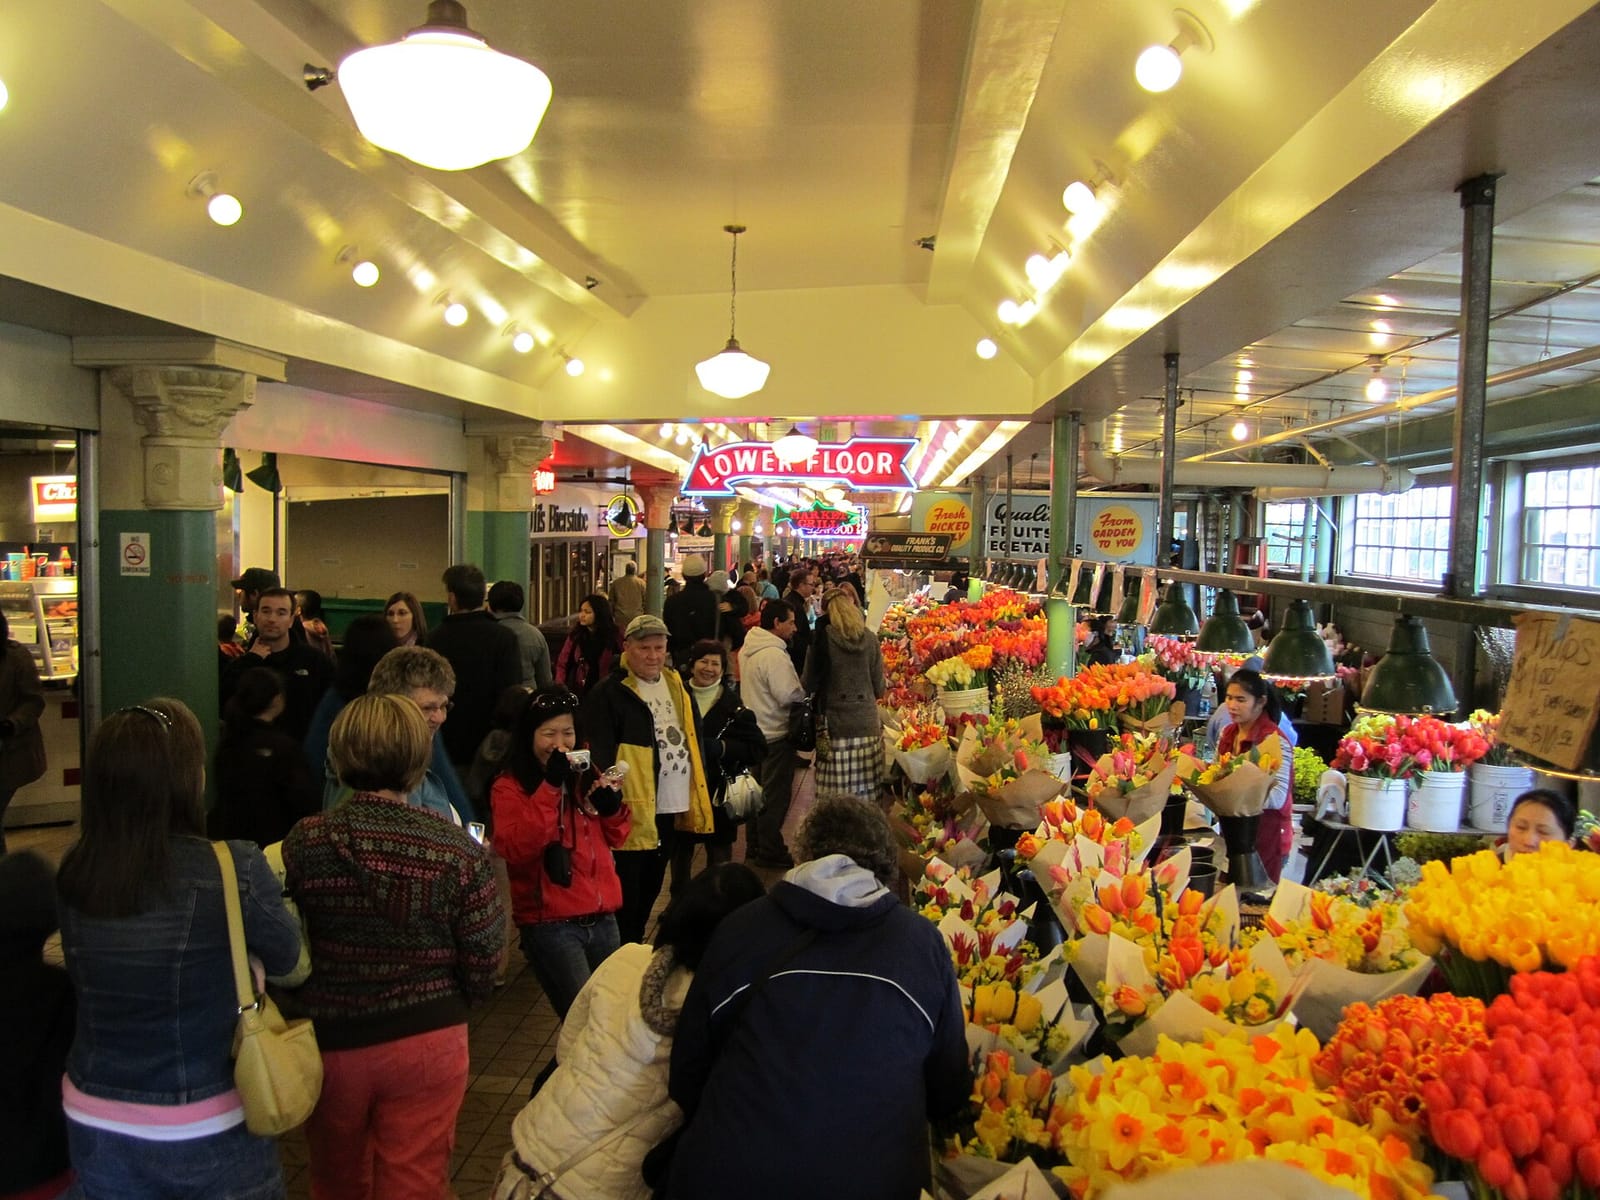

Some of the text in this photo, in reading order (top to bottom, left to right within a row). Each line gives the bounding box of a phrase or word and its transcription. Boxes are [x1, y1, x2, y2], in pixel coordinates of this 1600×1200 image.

[699, 449, 893, 486] LOWER FLOOR
[548, 504, 589, 533] Bierstube
[790, 511, 848, 520] MARKET
[934, 505, 966, 521] Fresh
[797, 520, 837, 529] GRILL
[1099, 513, 1135, 528] From
[929, 521, 970, 532] PICKED
[1093, 528, 1136, 539] GARDEN
[905, 536, 937, 545] FRANK'S
[1099, 538, 1136, 549] TO YOU
[890, 544, 913, 553] QUALITY
[911, 545, 935, 554] PRODUCE
